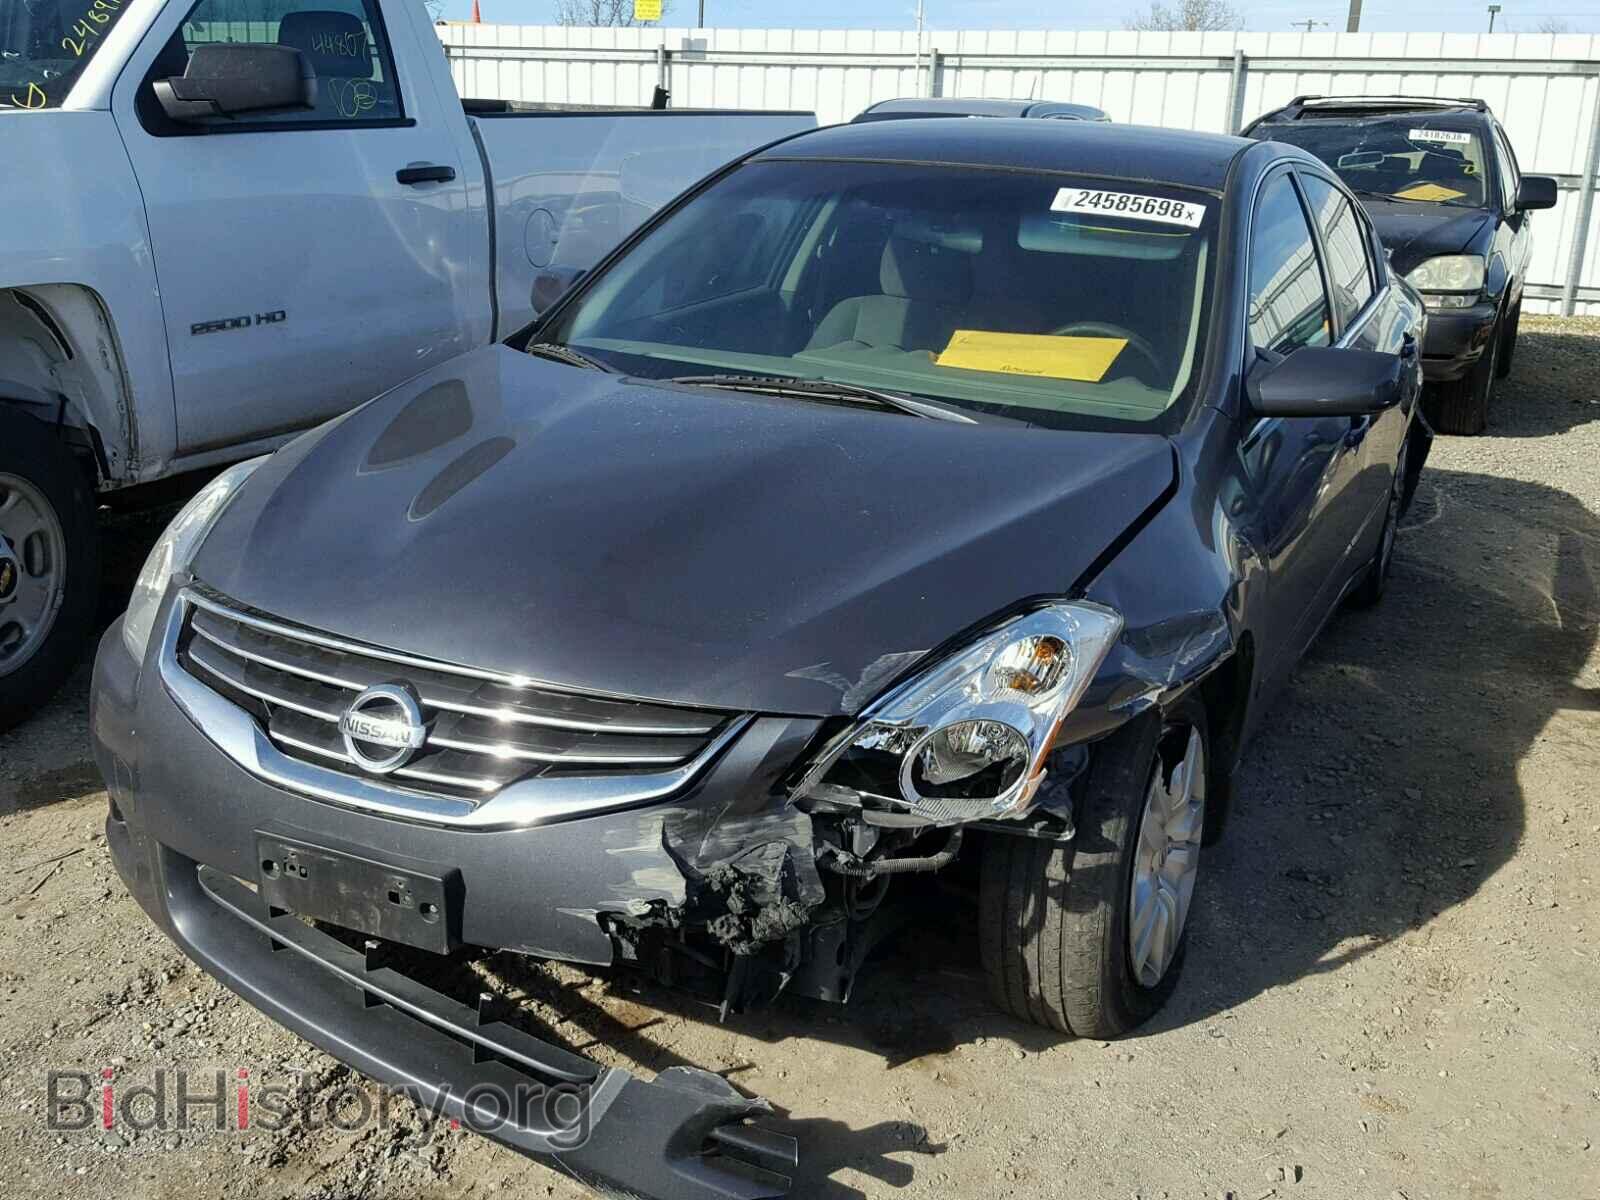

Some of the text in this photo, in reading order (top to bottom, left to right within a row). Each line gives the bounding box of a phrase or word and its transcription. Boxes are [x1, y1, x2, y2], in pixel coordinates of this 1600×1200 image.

[191, 310, 287, 335] 2500 HD
[344, 717, 411, 743] NISSAN
